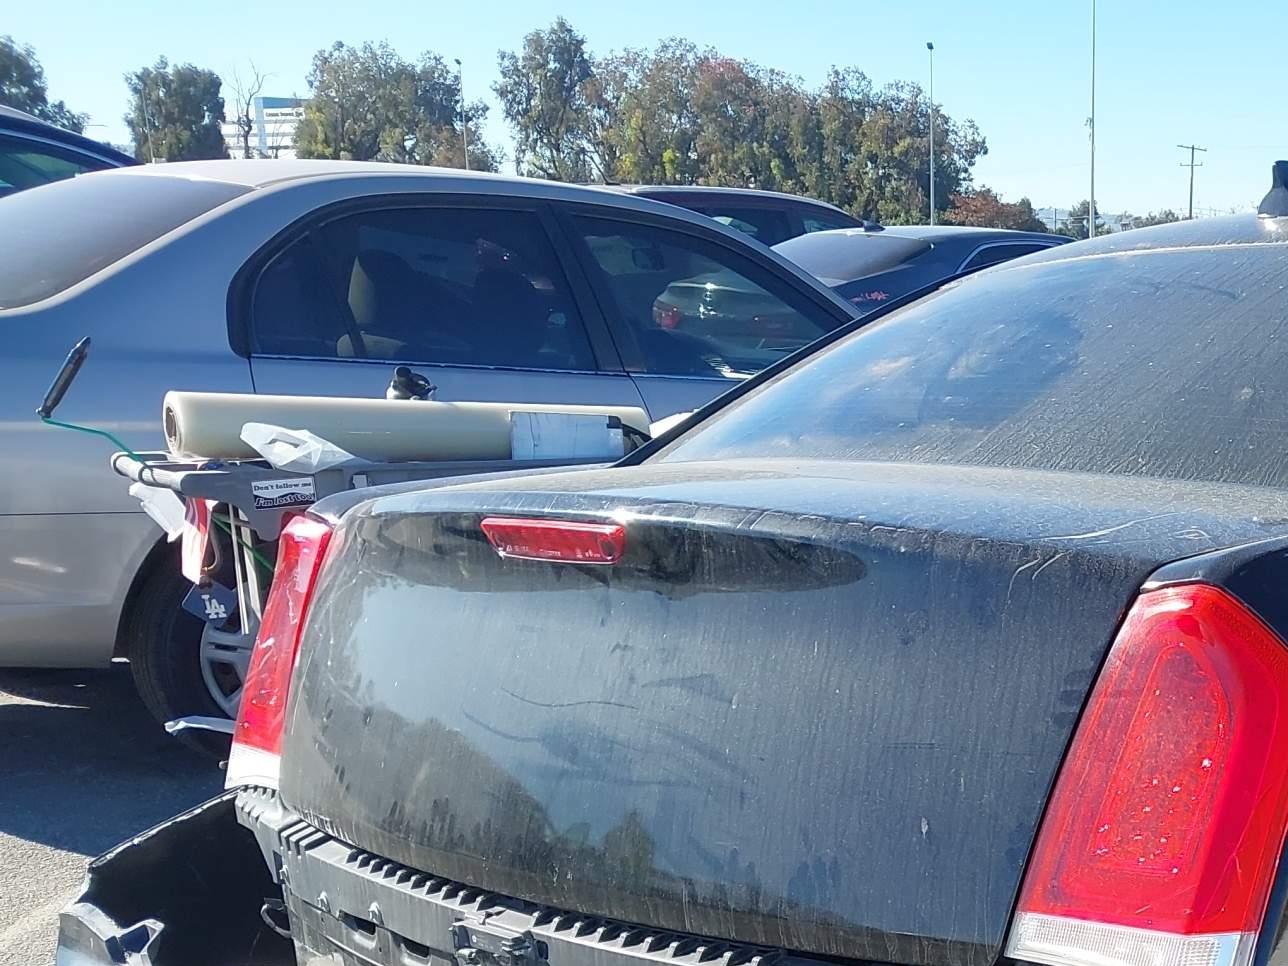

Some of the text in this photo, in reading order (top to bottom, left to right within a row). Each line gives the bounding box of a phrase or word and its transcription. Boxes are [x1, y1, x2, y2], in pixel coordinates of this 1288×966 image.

[275, 482, 300, 490] follow
[255, 497, 273, 507] I'm
[274, 495, 295, 505] lost
[201, 594, 228, 619] LA
